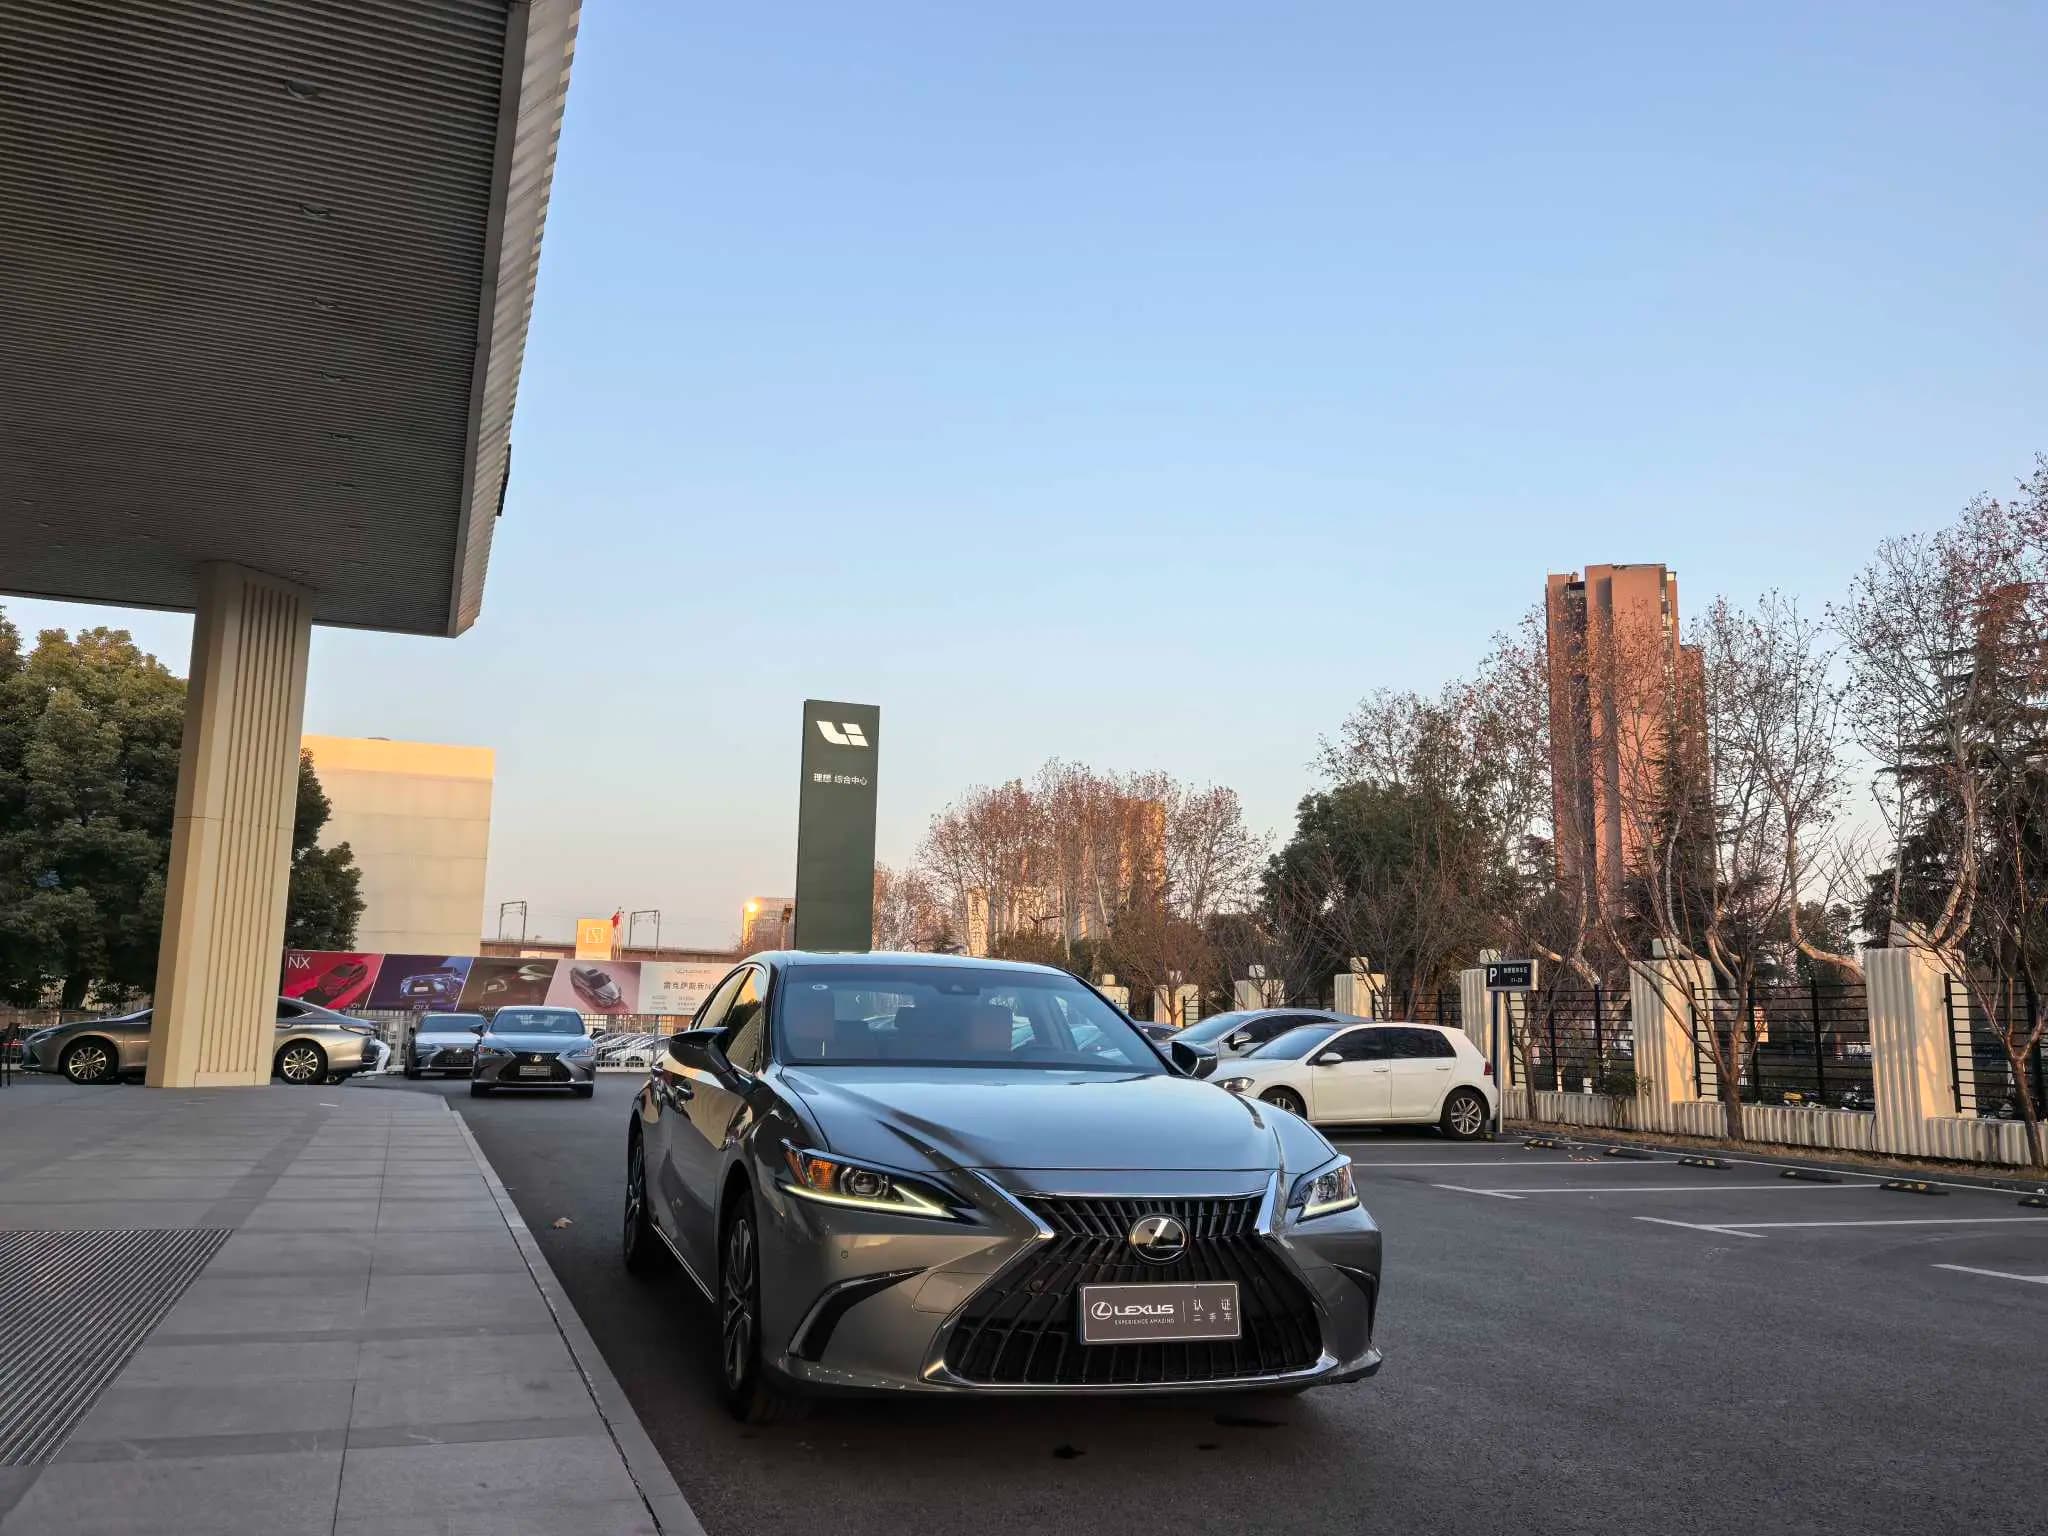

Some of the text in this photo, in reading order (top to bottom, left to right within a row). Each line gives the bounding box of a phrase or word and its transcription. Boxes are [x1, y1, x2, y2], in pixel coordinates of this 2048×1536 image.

[834, 775, 868, 786] 综合中心
[288, 956, 311, 969] NX
[1489, 967, 1498, 983] P
[1114, 1304, 1174, 1316] LEXUS
[1193, 1299, 1231, 1311] 认证
